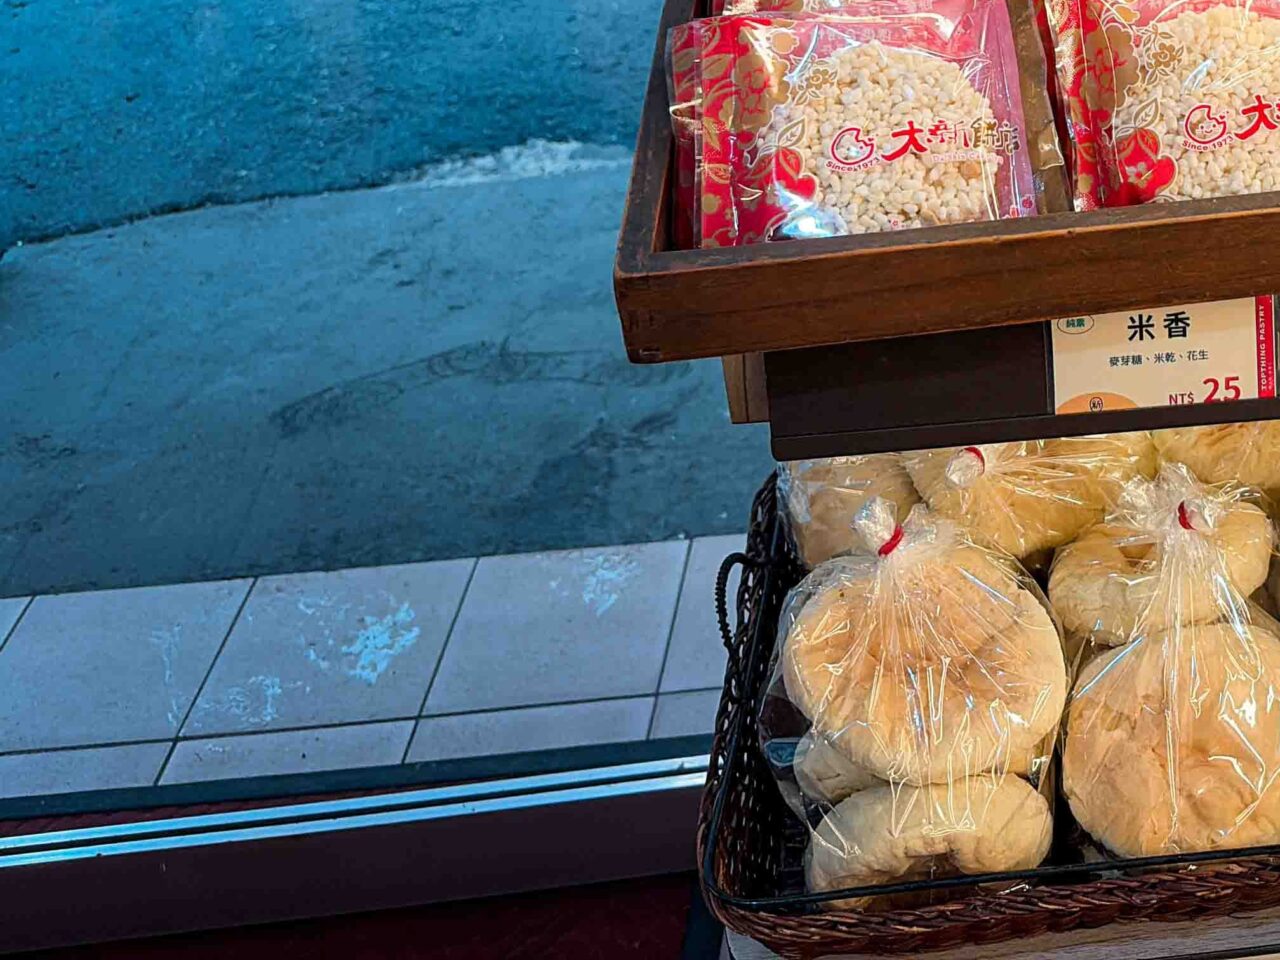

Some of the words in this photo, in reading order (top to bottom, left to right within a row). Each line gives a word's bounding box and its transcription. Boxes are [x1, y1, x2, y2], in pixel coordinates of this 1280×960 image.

[1182, 139, 1209, 151] Since
[1213, 134, 1234, 149] 1973
[825, 160, 853, 172] Since
[1127, 311, 1191, 342] 米香
[1168, 391, 1195, 405] NT$
[1202, 376, 1242, 404] 25
